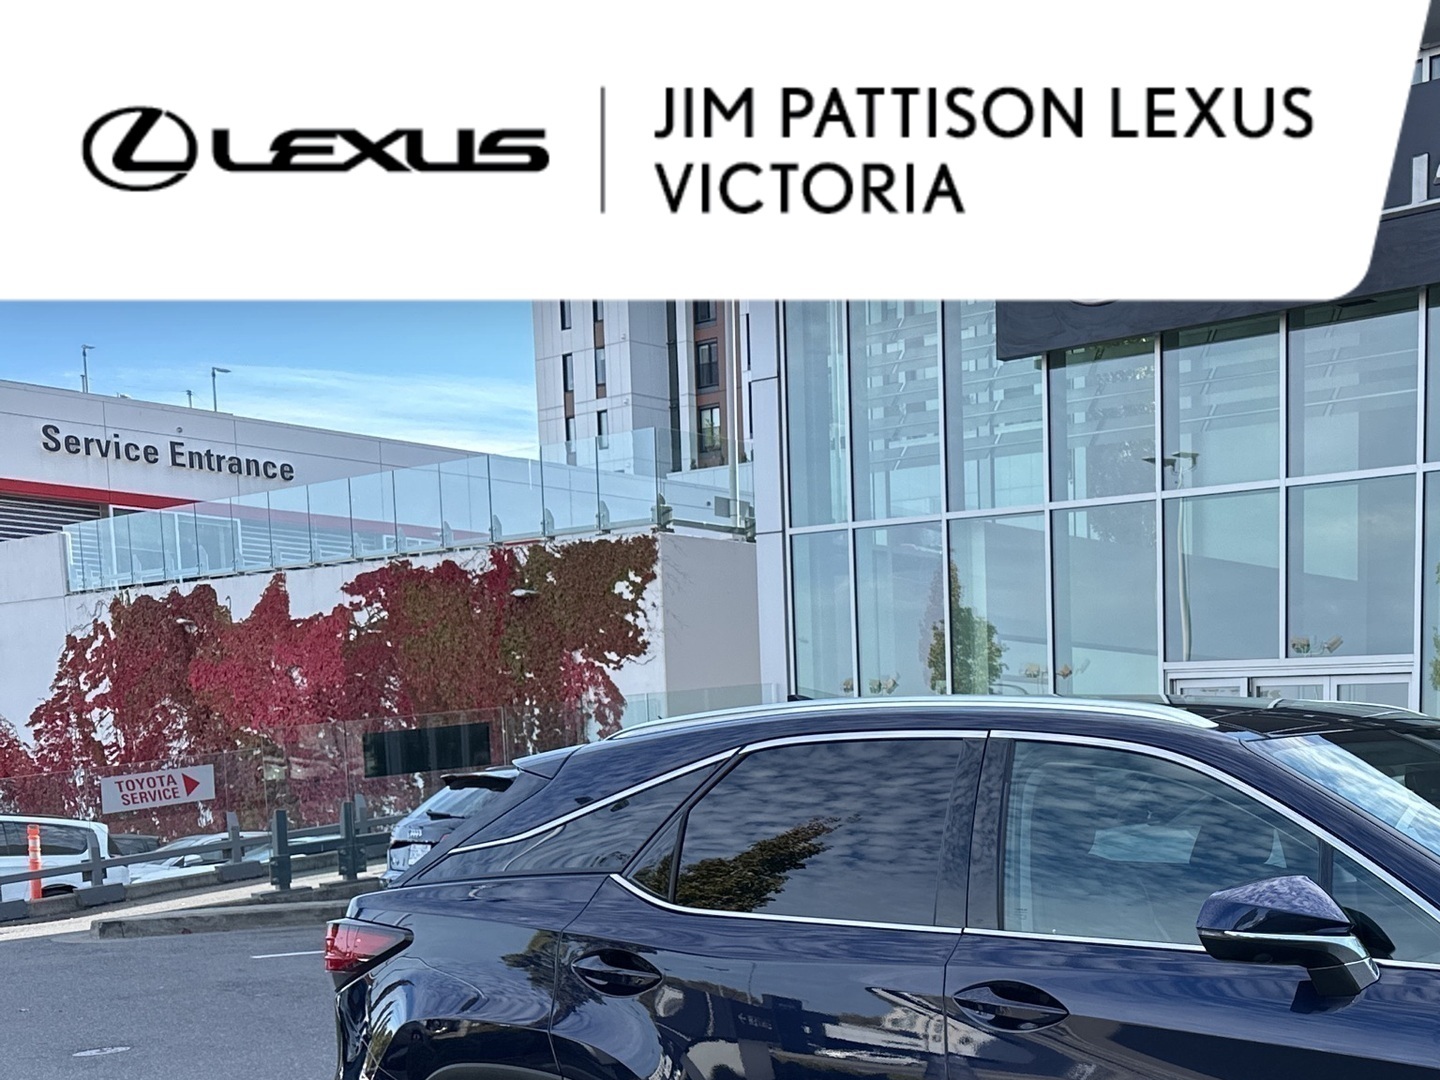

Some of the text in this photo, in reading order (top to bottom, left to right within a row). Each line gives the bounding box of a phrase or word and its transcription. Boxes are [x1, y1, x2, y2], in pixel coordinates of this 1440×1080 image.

[42, 424, 295, 482] Service Entrance
[115, 774, 178, 793] TOYOTA
[121, 787, 181, 807] SERVICE
